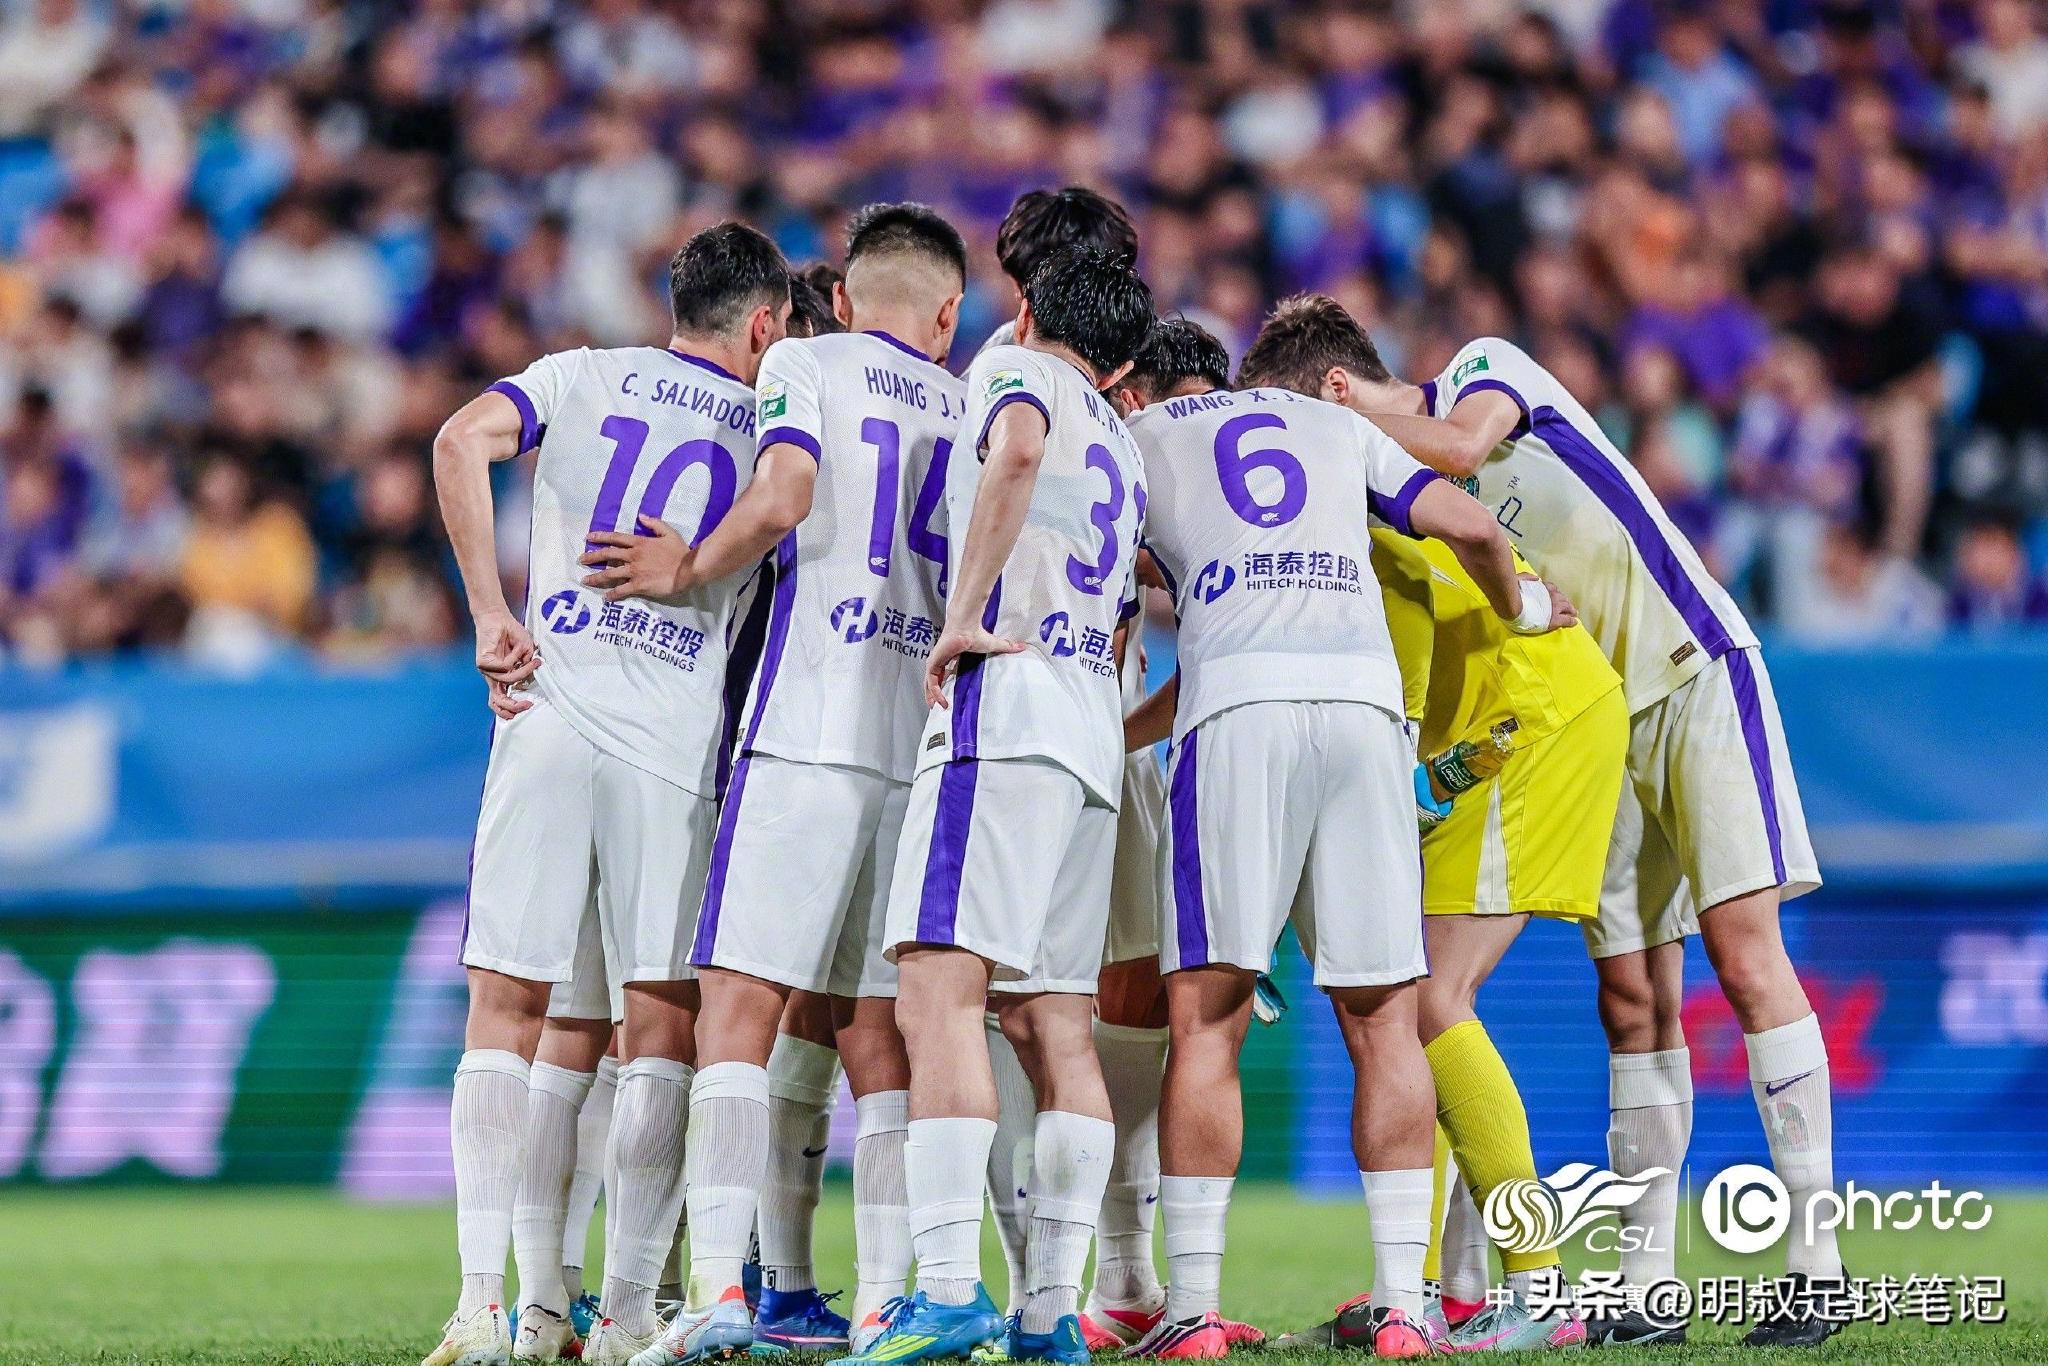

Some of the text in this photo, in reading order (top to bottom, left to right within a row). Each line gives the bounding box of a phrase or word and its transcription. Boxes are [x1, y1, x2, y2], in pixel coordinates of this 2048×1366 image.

[621, 373, 639, 397] C.
[865, 366, 926, 410] HUANG
[1164, 395, 1234, 419] WANG
[1213, 413, 1308, 528] 6
[584, 415, 737, 570] 10
[1244, 551, 1361, 584] 海泰控股
[1247, 578, 1363, 595] HITECH HOLDINGS
[597, 601, 705, 660] 海泰控股
[882, 636, 918, 658] HITECH
[593, 630, 696, 673] HITECH HOLDINGS
[1079, 656, 1117, 679] HITECH
